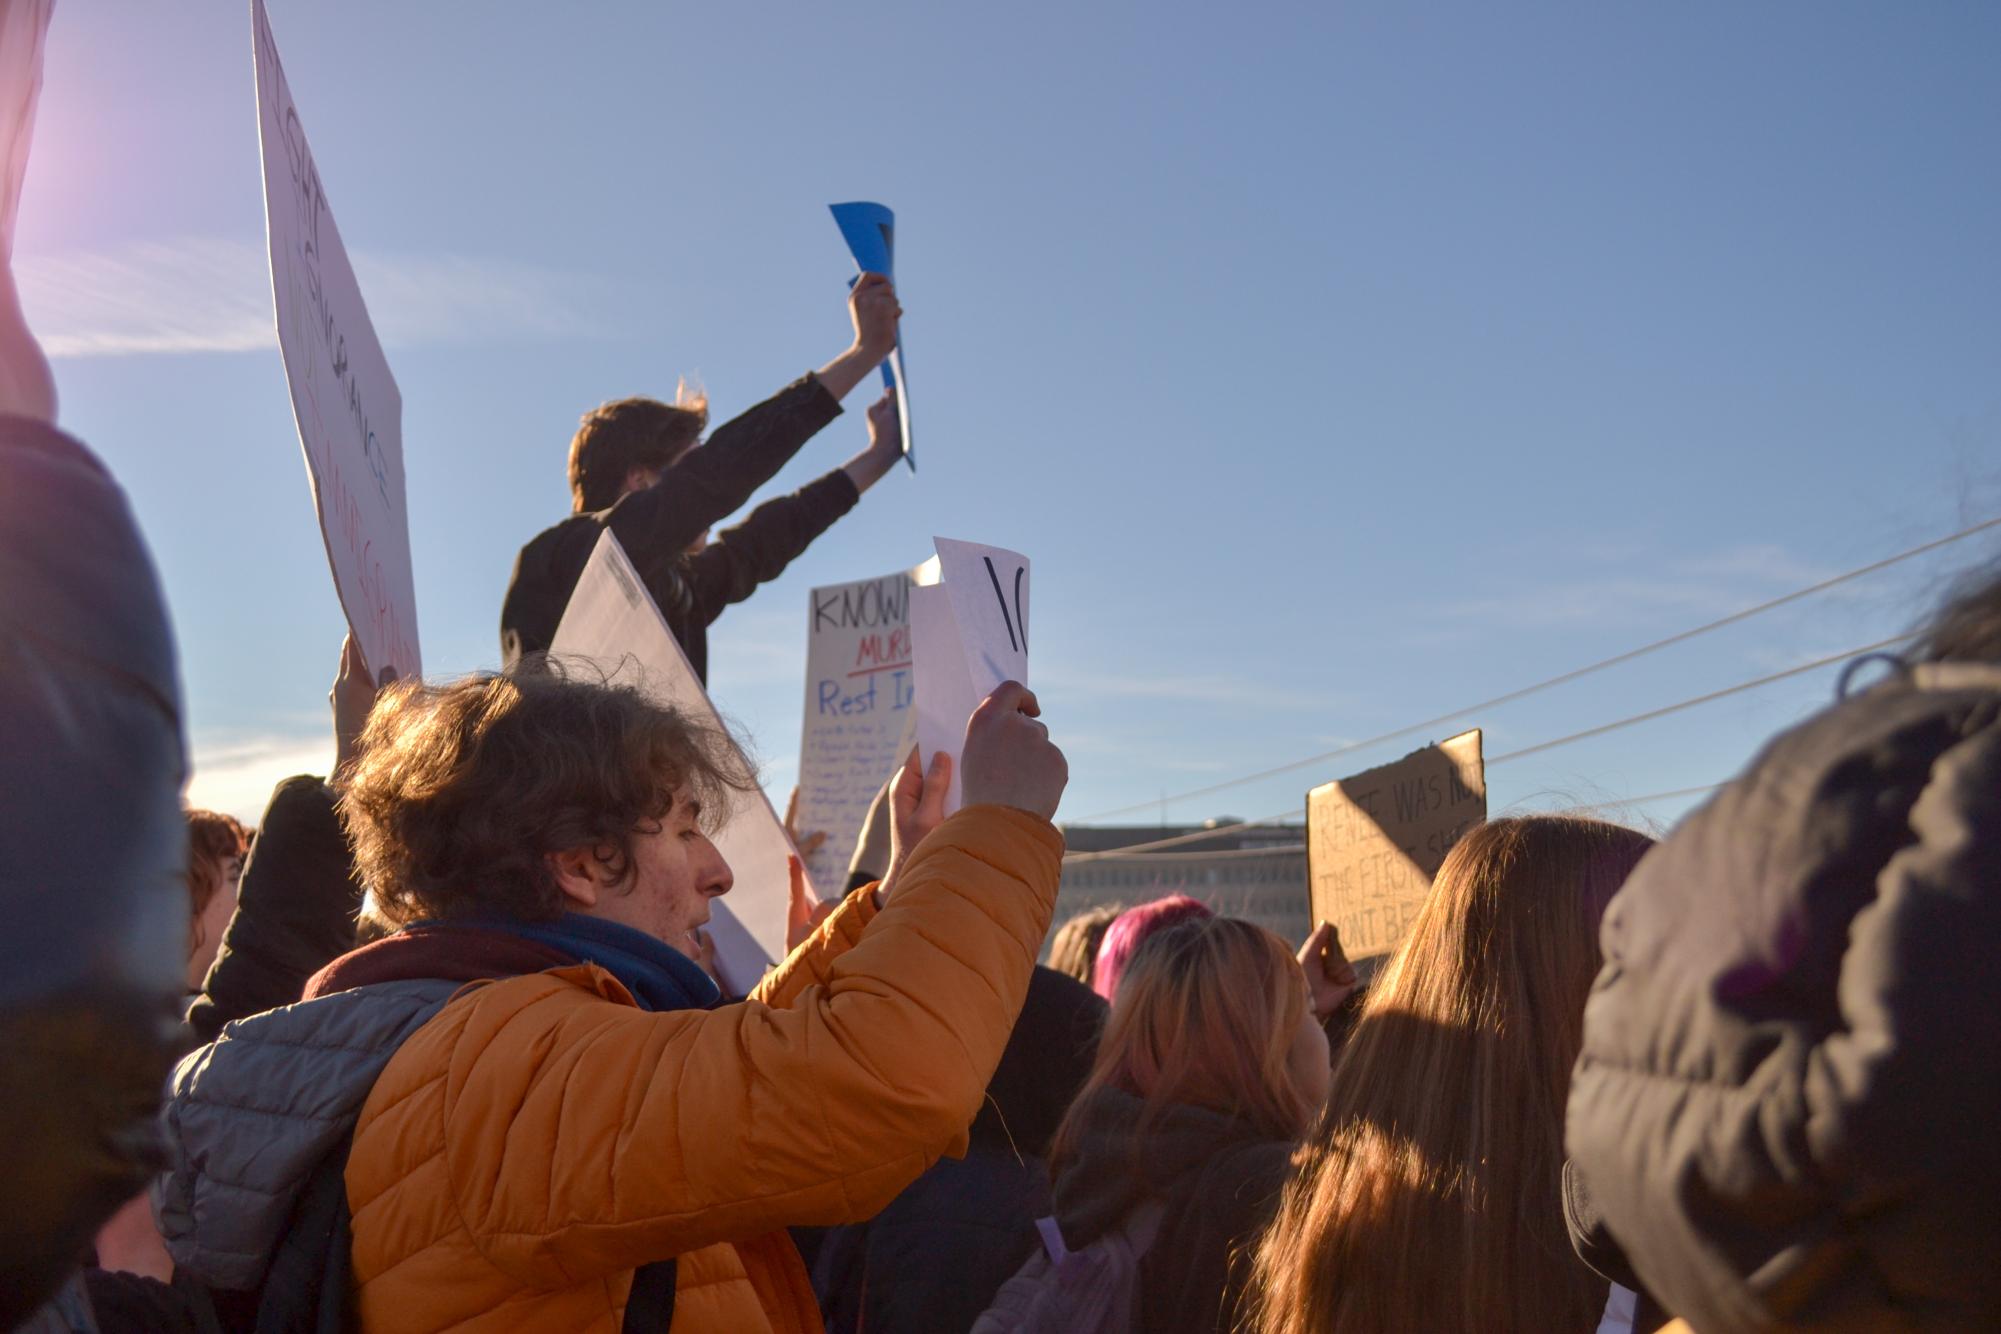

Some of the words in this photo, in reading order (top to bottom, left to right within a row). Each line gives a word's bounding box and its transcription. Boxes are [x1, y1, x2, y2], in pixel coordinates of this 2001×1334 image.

[818, 675, 877, 716] Rest
[1392, 775, 1442, 824] WAS
[1337, 906, 1377, 949] ONT
